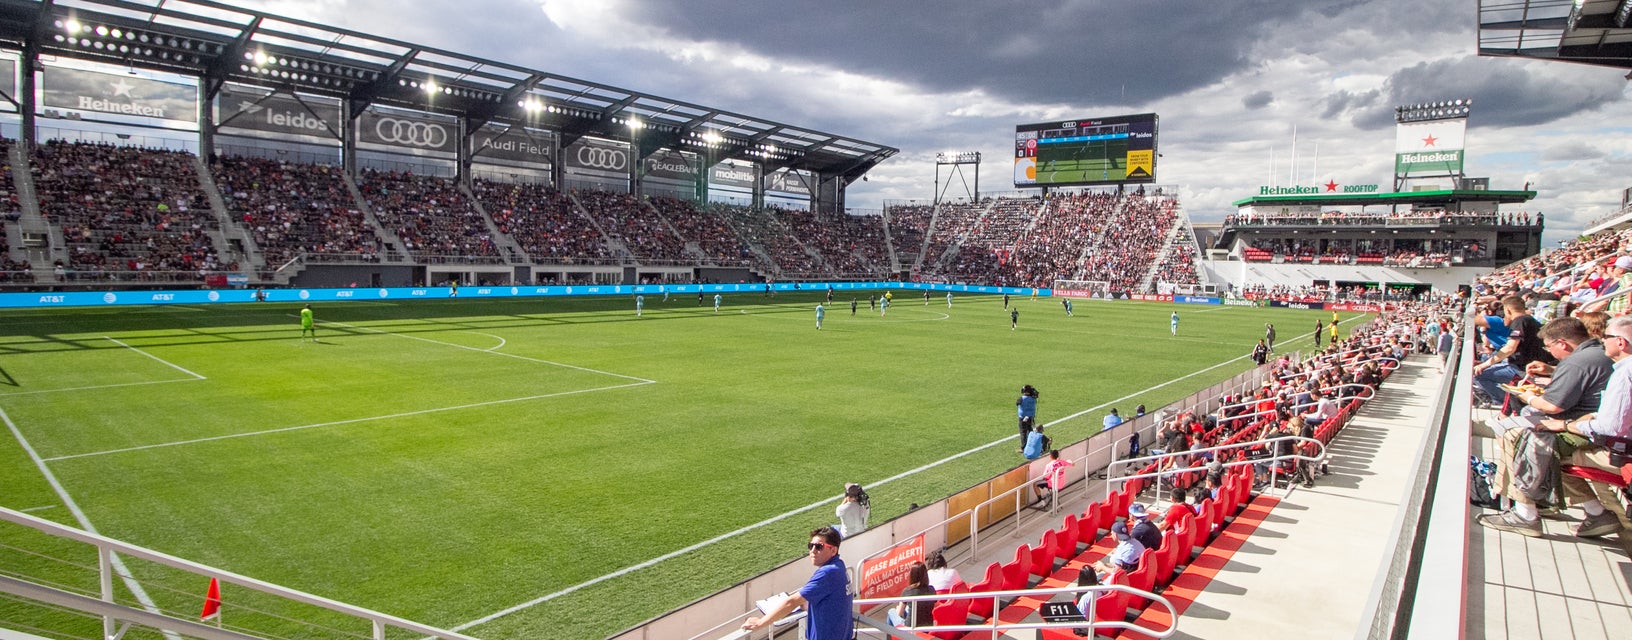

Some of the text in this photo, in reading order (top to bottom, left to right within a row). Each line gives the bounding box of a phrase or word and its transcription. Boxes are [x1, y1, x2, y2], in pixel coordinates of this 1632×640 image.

[78, 95, 165, 117] Heineken
[267, 108, 327, 131] leidos
[482, 138, 550, 155] Audi Field
[1401, 152, 1459, 164] Heineken
[715, 170, 755, 182] mobilitie
[1260, 184, 1378, 195] Heineken ROOFTOP
[40, 295, 65, 303] AT&T
[1224, 298, 1254, 306] Heineke
[1288, 302, 1309, 310] leidos
[889, 557, 898, 567] BE
[897, 546, 923, 563] ALERT!
[882, 567, 897, 580] MAY
[876, 579, 893, 592] FIELD
[894, 575, 904, 585] OF
[1050, 604, 1069, 615] F11
